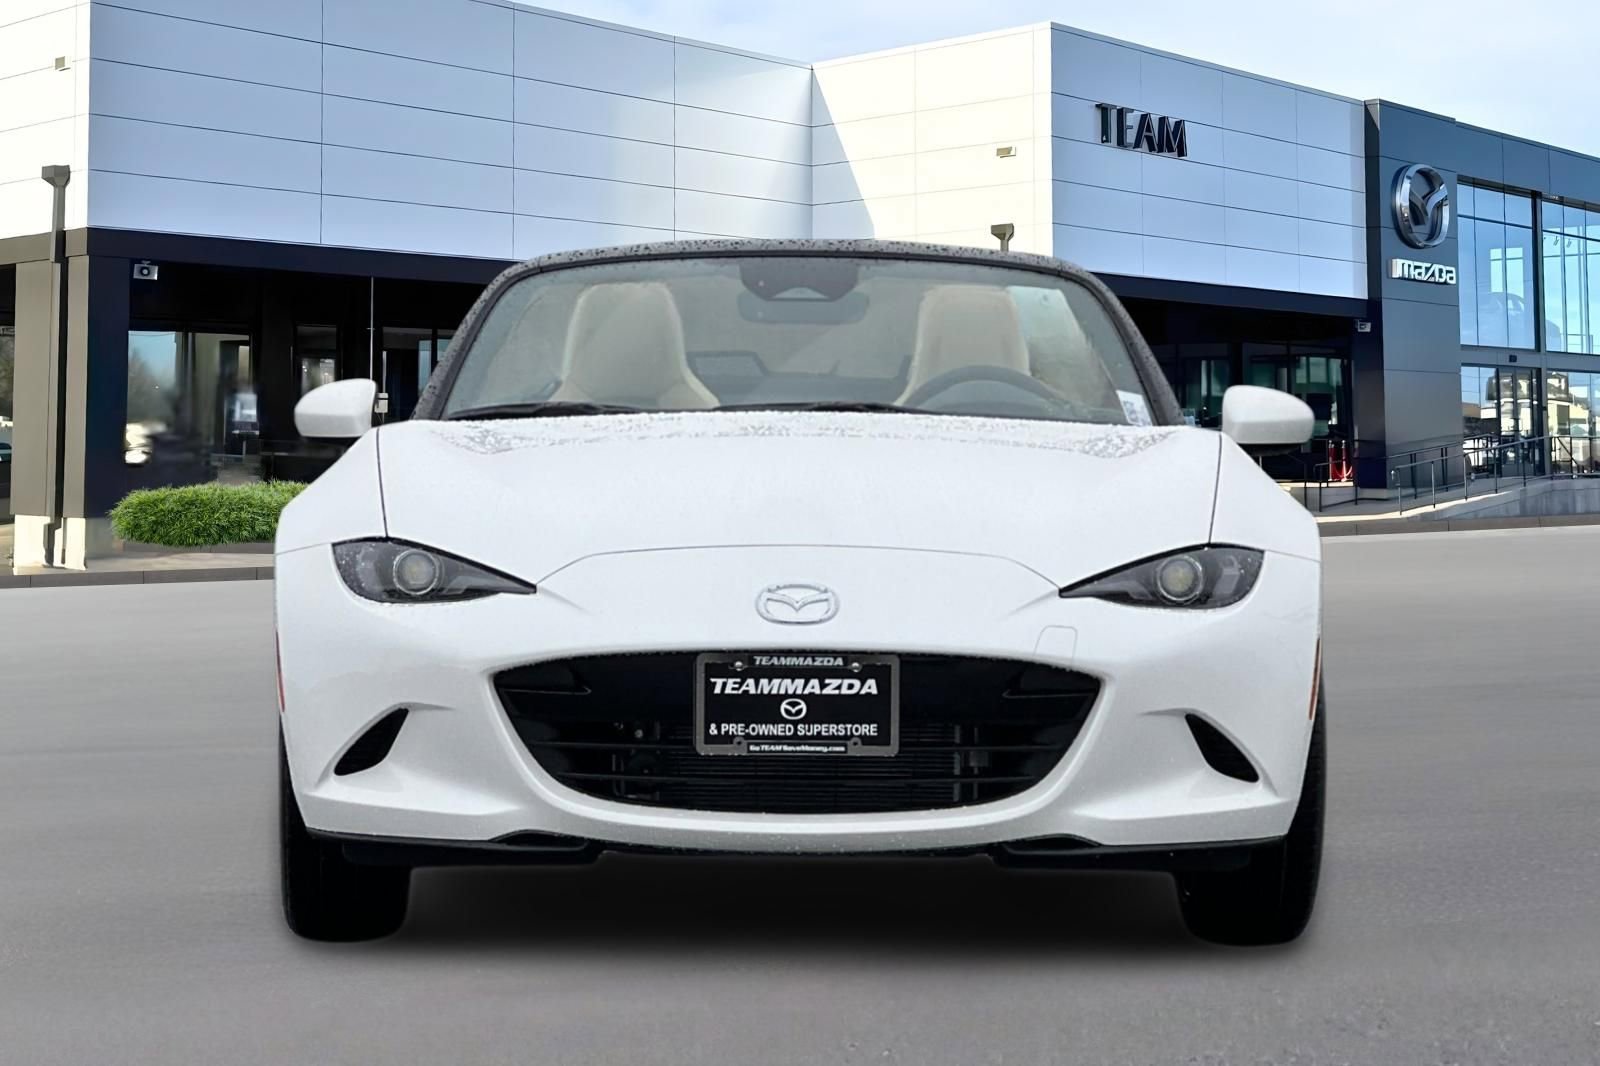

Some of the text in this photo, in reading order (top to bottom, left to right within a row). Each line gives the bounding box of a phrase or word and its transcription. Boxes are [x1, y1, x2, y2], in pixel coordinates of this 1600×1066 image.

[1095, 103, 1188, 158] TEAM
[753, 656, 844, 666] TEAMMAZDA
[709, 678, 878, 695] TEAMMAZDA
[709, 723, 878, 737] & PRE-OWNED SUPERSTORE
